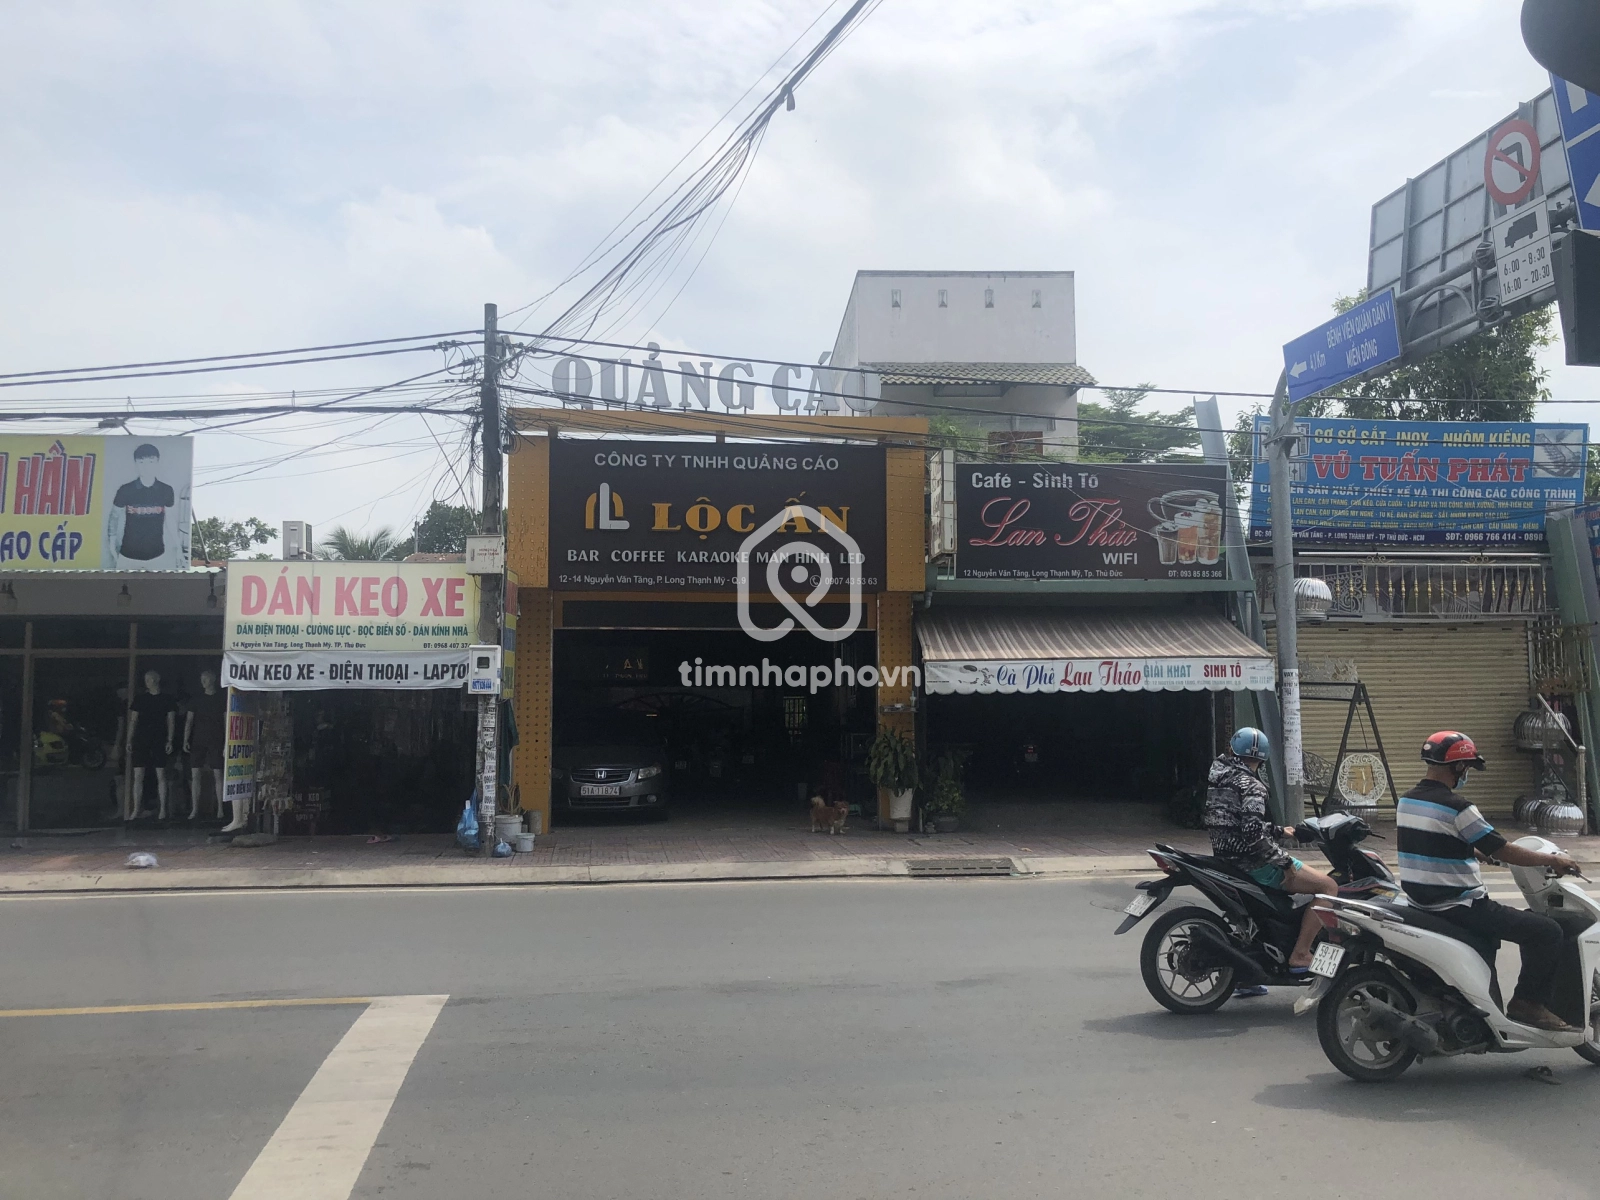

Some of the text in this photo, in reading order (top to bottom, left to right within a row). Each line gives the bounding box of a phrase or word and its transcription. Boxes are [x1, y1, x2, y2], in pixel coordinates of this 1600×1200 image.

[1504, 246, 1545, 276] 6:00 8:30
[1503, 264, 1550, 295] 16:00 20:30
[1326, 325, 1343, 350] BỆNH
[1355, 308, 1373, 334] QUÂN
[1372, 301, 1387, 326] DÂN
[1385, 300, 1391, 319] Y
[551, 341, 882, 413] QUẢNG CÁO
[1314, 425, 1531, 447] CƠ SỞ SẮT INOX NHÔM KIẾNG
[594, 451, 839, 471] CÔNG TY TNHH QUẢNG CÁO
[1312, 449, 1530, 482] VŨ TUẤN PHÁT
[972, 471, 1100, 489] Café Sinh Tố
[1308, 483, 1329, 494] SẢN
[1431, 488, 1449, 497] THI
[1452, 486, 1482, 498] CÔNG
[1485, 487, 1508, 498] CÁC
[1510, 487, 1541, 498] CÔNG
[1544, 487, 1576, 499] TRÌNH
[651, 491, 850, 540] LỘC ẤN
[968, 496, 1047, 547] Lan
[1054, 497, 1138, 547] Thảo
[38, 521, 83, 562] CẤP
[1446, 532, 1462, 540] SĐT:
[1464, 533, 1484, 541] 0966
[1486, 532, 1500, 541] 766
[1501, 533, 1516, 541] 414
[567, 549, 866, 565] BAR COFFEE KARAOKE MÀN HÌNH LED
[1102, 552, 1139, 565] WIFI
[584, 574, 615, 585] Nguyễn
[616, 574, 632, 584] Văn
[633, 575, 656, 585] Tăng,
[665, 576, 685, 586] Long
[687, 576, 712, 587] Thạnh
[824, 577, 878, 586] 0907 43 53 63
[963, 569, 972, 577] 12
[972, 569, 998, 579] Nguyễn
[998, 569, 1012, 577] Văn
[1031, 569, 1049, 579] Long
[1084, 569, 1095, 579] Tp.
[1095, 569, 1109, 578] Thủ
[1109, 568, 1124, 578] Đức
[1180, 570, 1192, 579] 093
[1193, 570, 1201, 579] 85
[1201, 570, 1210, 579] 85
[1210, 570, 1222, 579] 366
[241, 566, 465, 617] DÁN KEO XE
[236, 622, 468, 638] DÁN ĐIỆN THOẠI CƯỜNG LỰC BỌC BIỂN SỐ DÁN KÍNH NHÀ
[290, 641, 303, 649] Long
[229, 660, 259, 680] DÁN
[263, 664, 292, 680] KEO
[296, 664, 315, 680] XE
[329, 660, 363, 684] ĐIỆN
[367, 663, 409, 684] THOẠI
[996, 664, 1018, 686] Cà
[1022, 664, 1055, 690] Phê
[1059, 661, 1093, 687] Lan
[1098, 660, 1141, 687] Thảo
[1203, 664, 1227, 678] SINH
[1229, 659, 1242, 678] TỐ
